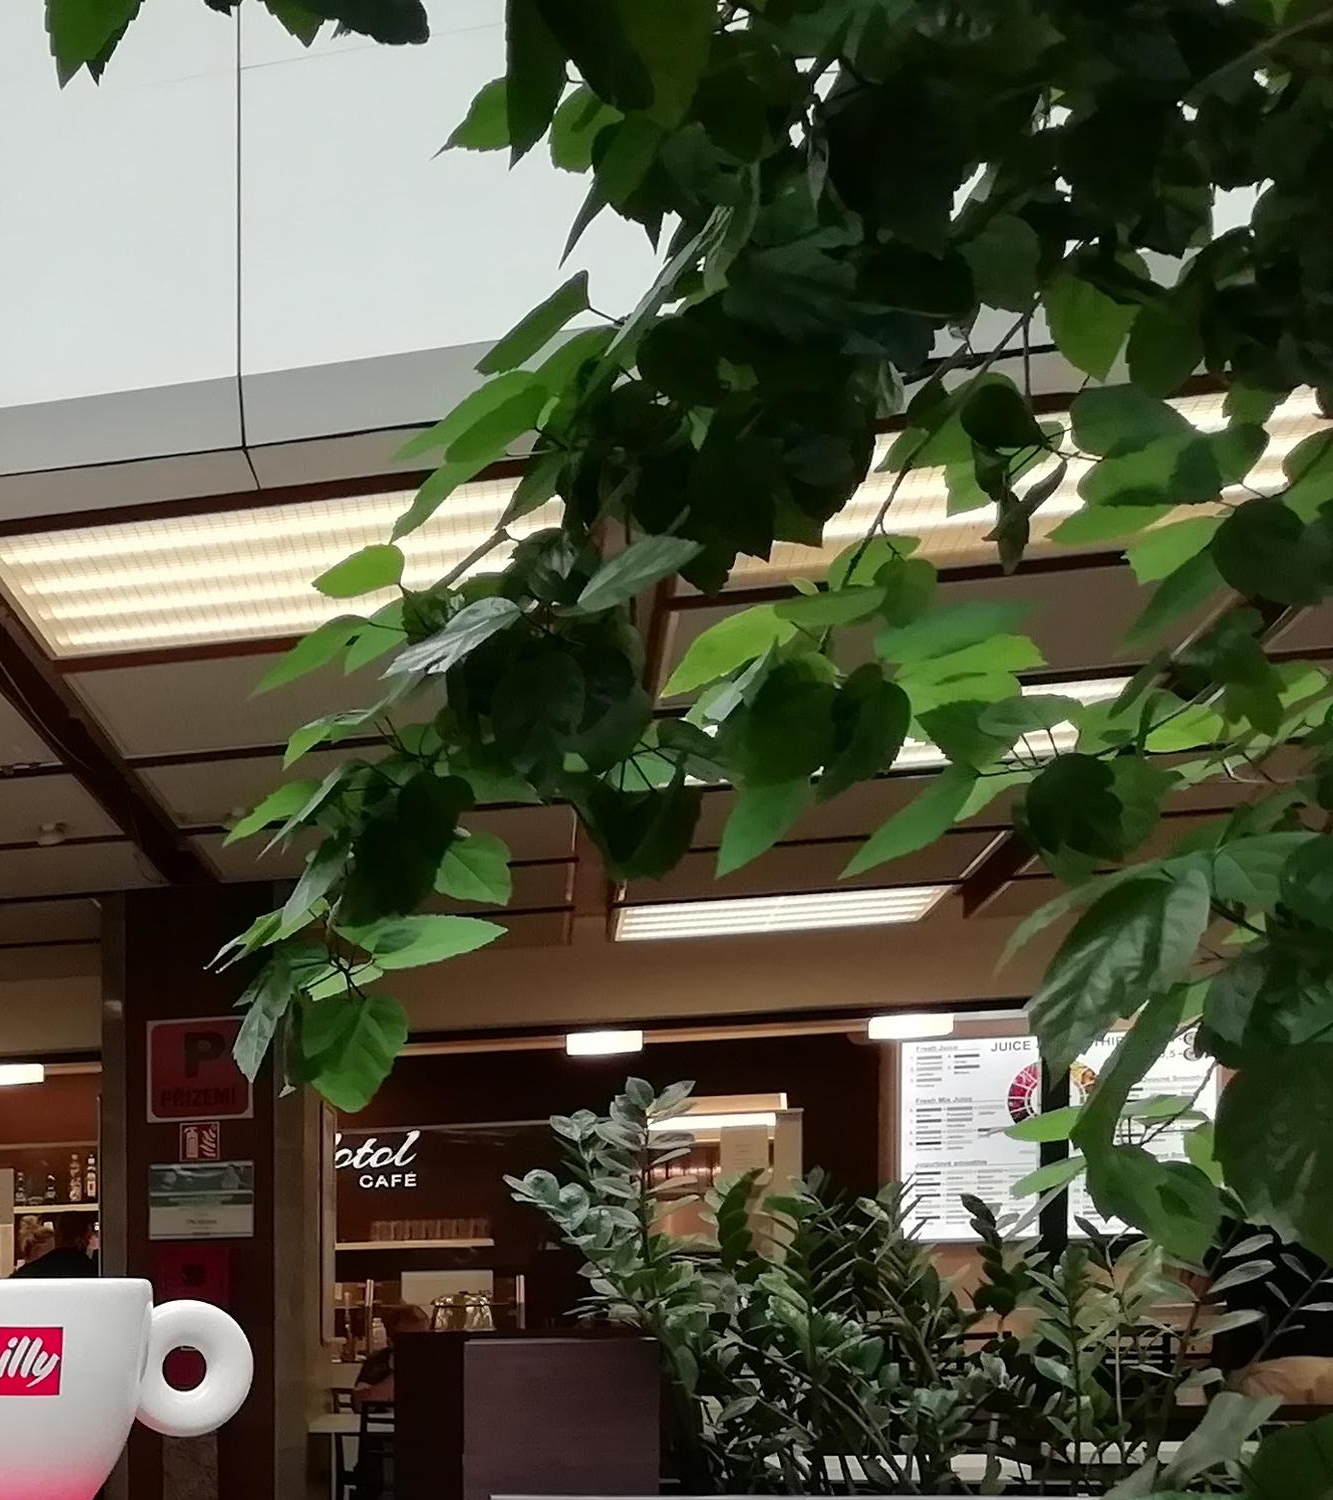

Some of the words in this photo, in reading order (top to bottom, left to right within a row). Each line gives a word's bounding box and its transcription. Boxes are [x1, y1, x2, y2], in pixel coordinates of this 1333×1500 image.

[990, 1040, 1032, 1052] JUICE
[335, 1130, 420, 1169] otol
[359, 1171, 417, 1189] CAFÉ
